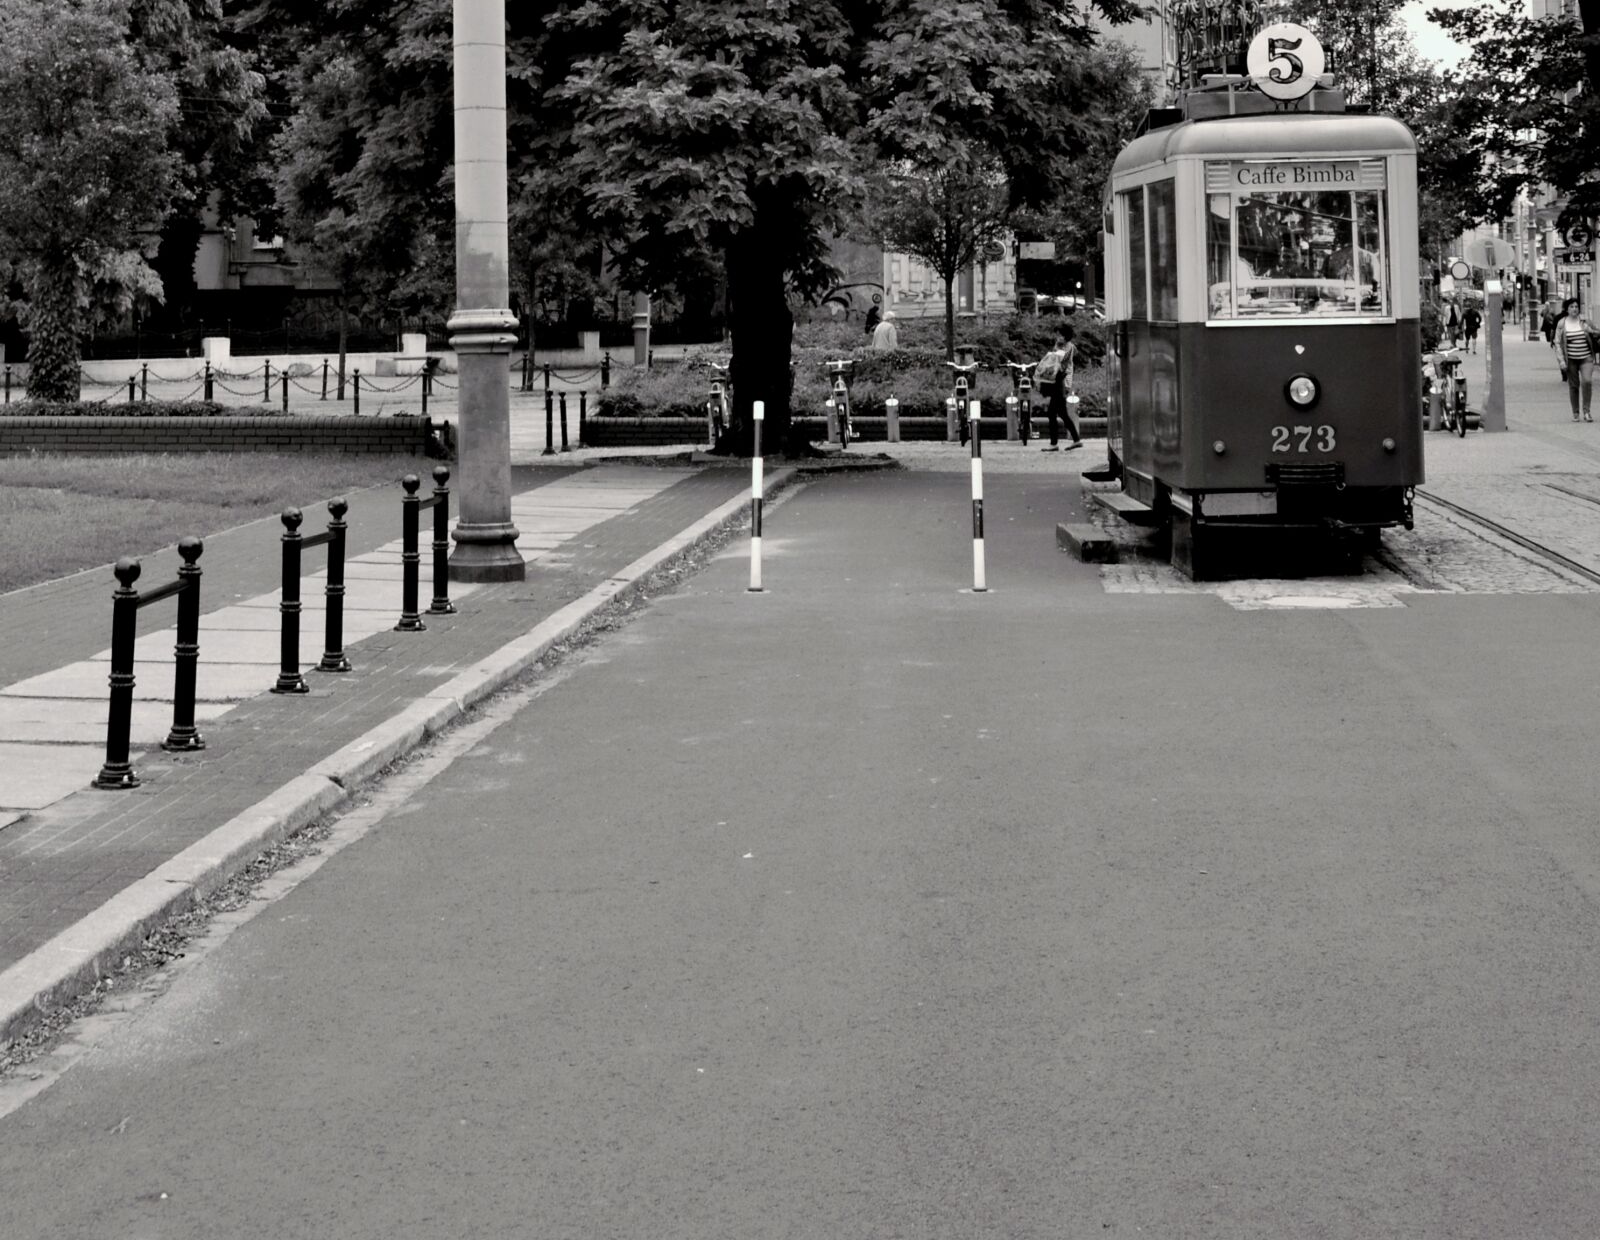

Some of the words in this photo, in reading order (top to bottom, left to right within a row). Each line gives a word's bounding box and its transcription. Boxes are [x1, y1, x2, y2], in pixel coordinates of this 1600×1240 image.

[1268, 38, 1303, 84] 5
[1237, 166, 1286, 185] Caffe
[1293, 165, 1355, 184] Bimba
[1271, 425, 1336, 452] 273
